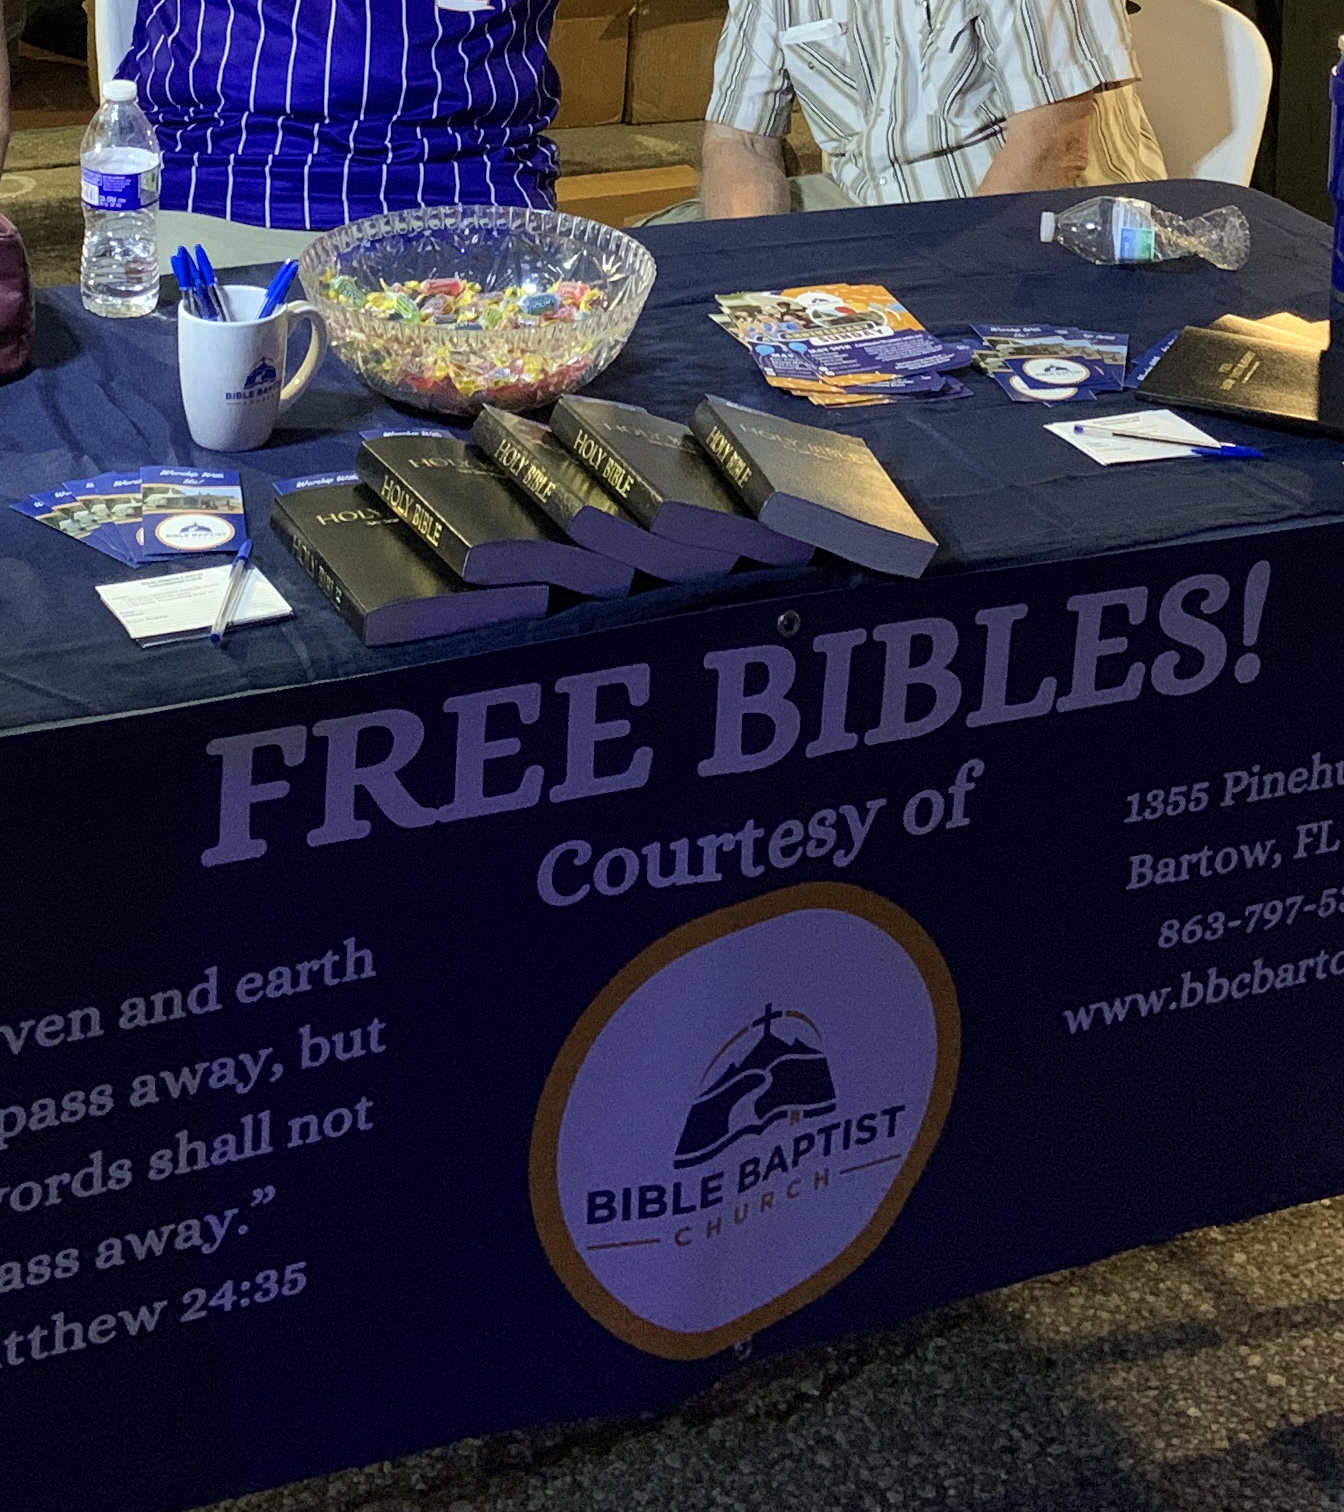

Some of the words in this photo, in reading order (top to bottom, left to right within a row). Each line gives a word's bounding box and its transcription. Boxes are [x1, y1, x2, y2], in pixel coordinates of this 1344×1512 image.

[493, 438, 530, 477] HOLY
[521, 462, 557, 504] BIBLE
[572, 428, 608, 470] HOLY
[602, 457, 635, 499] BIBLE
[706, 425, 734, 463] HOLY
[725, 450, 753, 489] BIBLE
[379, 474, 415, 517] HOLY
[411, 502, 443, 548] BIBLE
[200, 664, 655, 869] FREE
[698, 561, 1272, 778] BIBLES!
[537, 798, 887, 906] Courtesy
[903, 759, 985, 835] of
[1124, 782, 1209, 823] 1355
[1126, 840, 1282, 890] Bartow,
[1294, 820, 1340, 859] FL
[119, 966, 222, 1029] and
[236, 937, 376, 1003] earth
[130, 1048, 283, 1107] away,
[299, 1018, 386, 1069] but
[148, 1110, 273, 1180] shall
[288, 1097, 373, 1148] not
[587, 1171, 724, 1228] BIBLE
[736, 1105, 905, 1194] BAPTIST
[92, 1182, 276, 1269] away.”
[673, 1170, 830, 1246] CHURCH
[181, 1262, 306, 1322] 24:35
